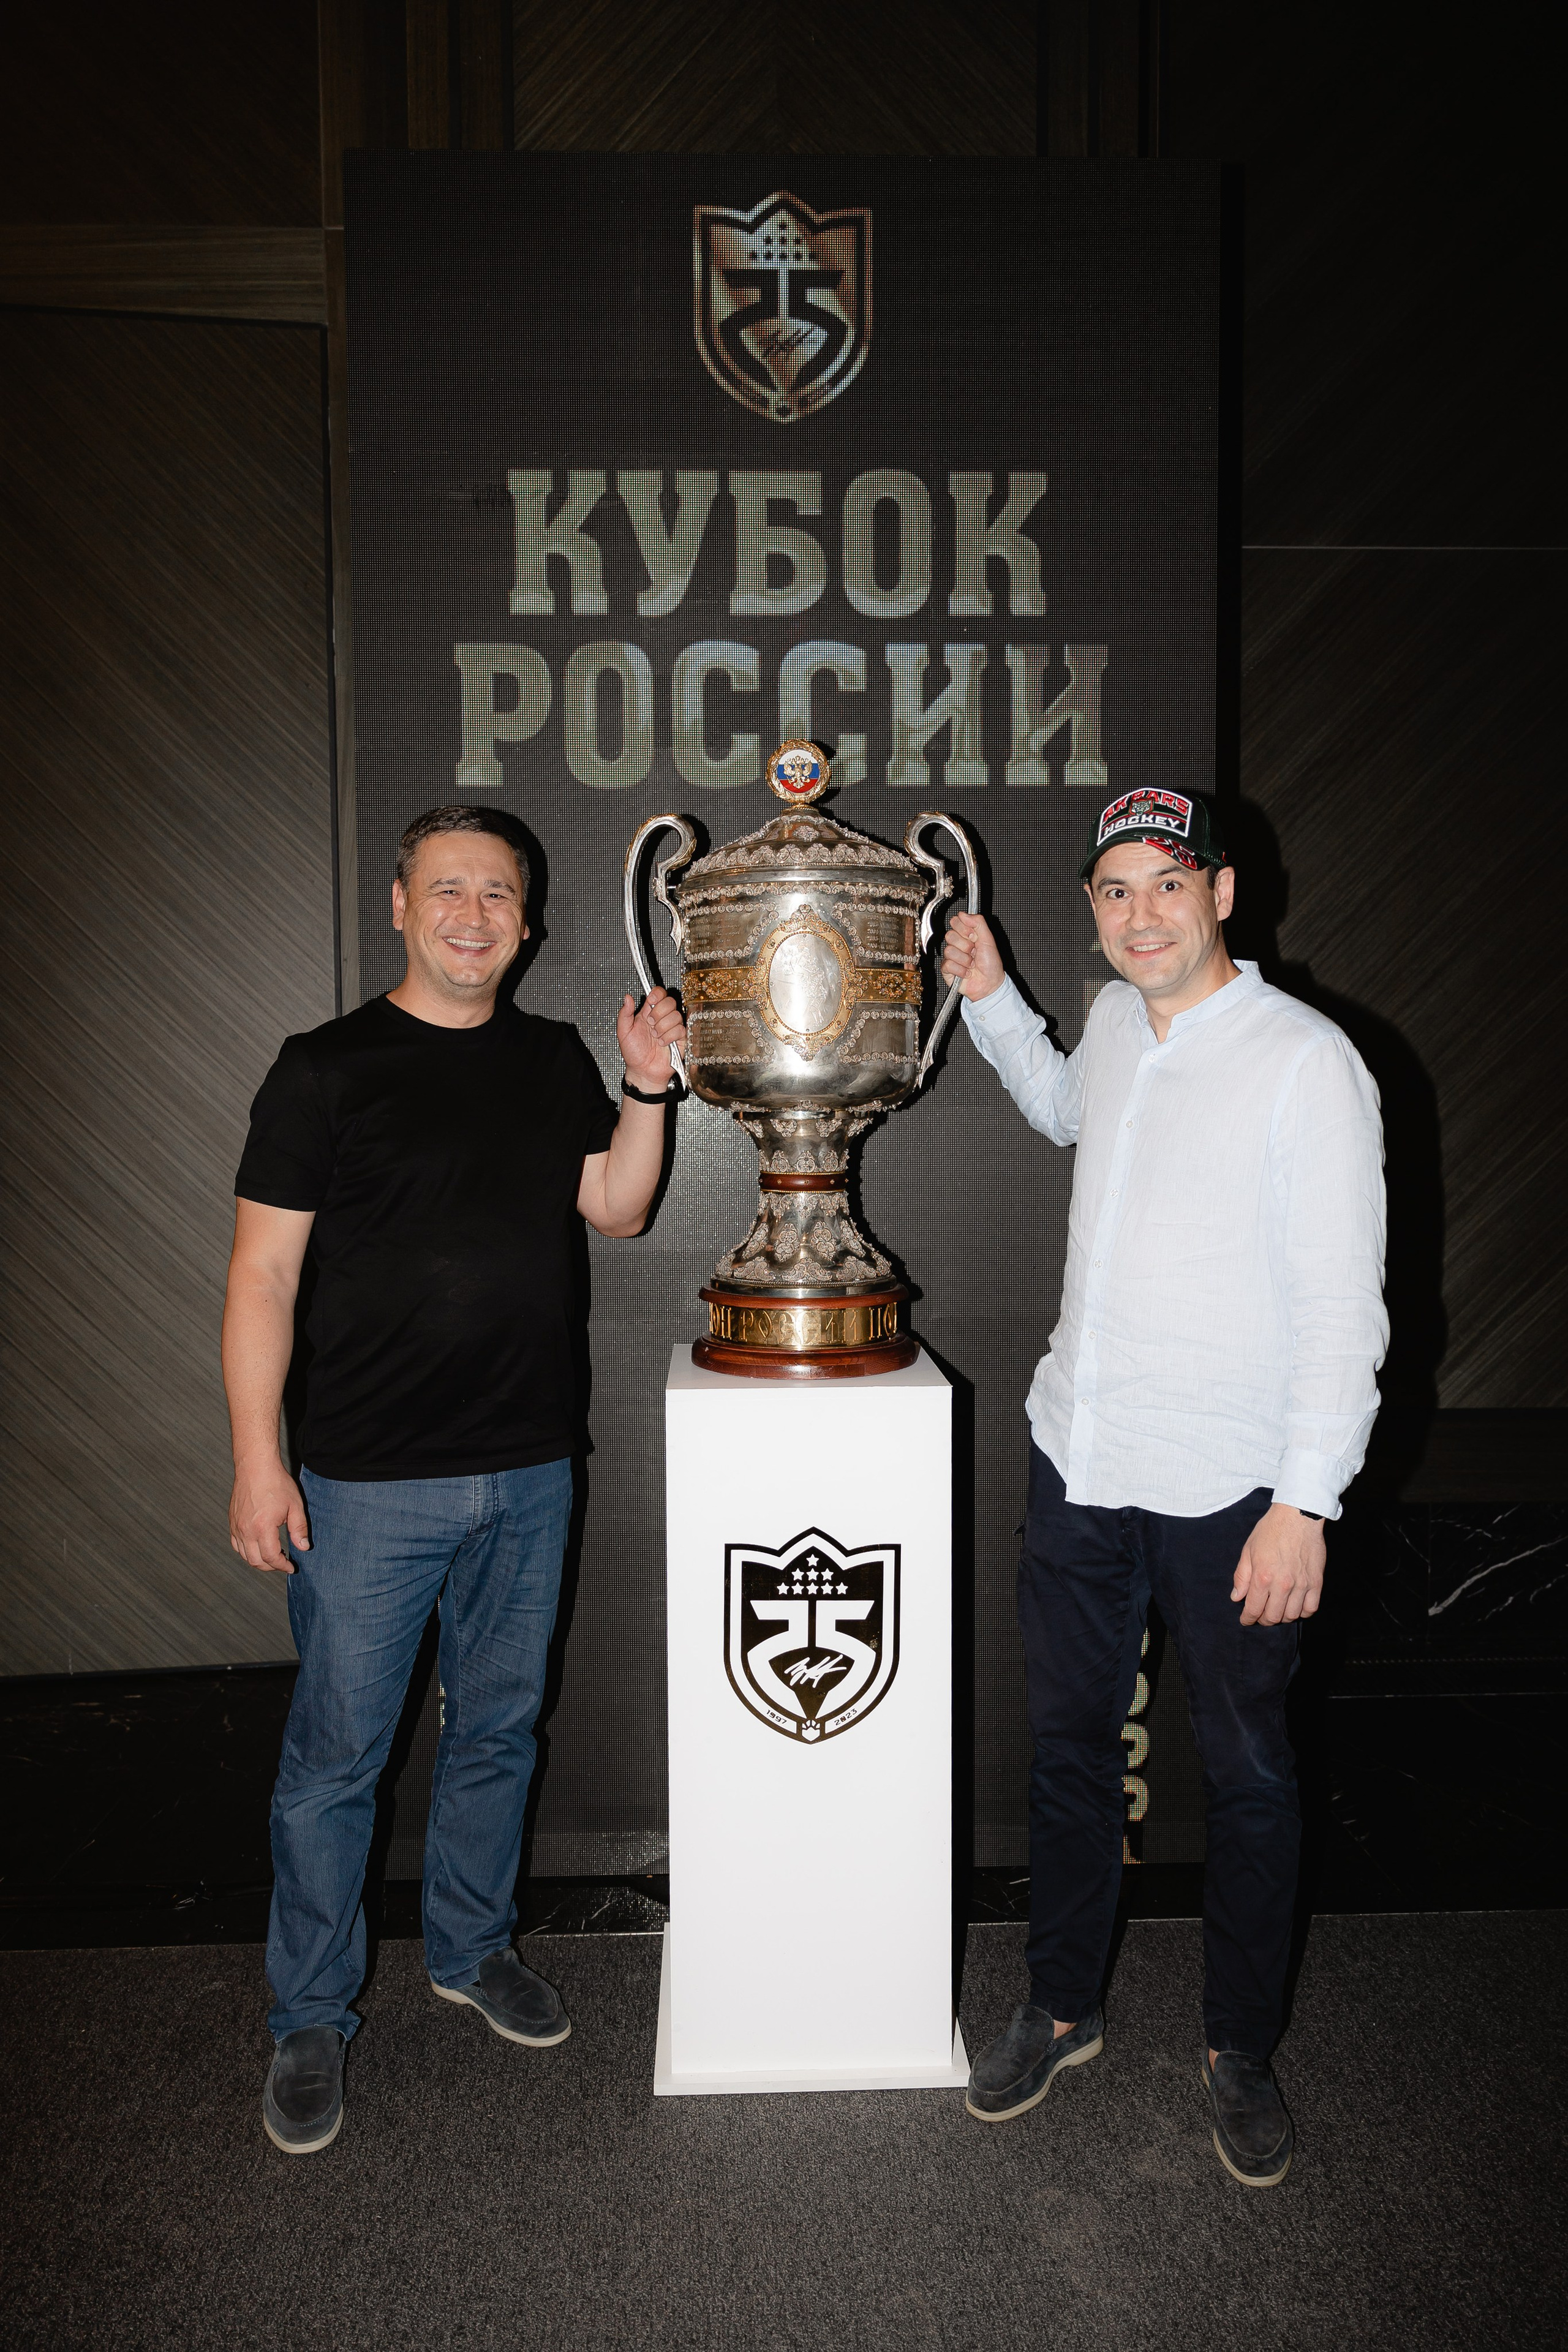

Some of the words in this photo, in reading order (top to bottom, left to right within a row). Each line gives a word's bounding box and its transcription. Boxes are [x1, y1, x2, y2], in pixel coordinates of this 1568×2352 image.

[507, 469, 1047, 618] КУБОК
[454, 640, 1108, 788] РОССИИ
[1102, 796, 1129, 823] AK
[1104, 814, 1180, 836] HOCKEY
[765, 1709, 788, 1725] 1997
[834, 1708, 858, 1726] 2023
